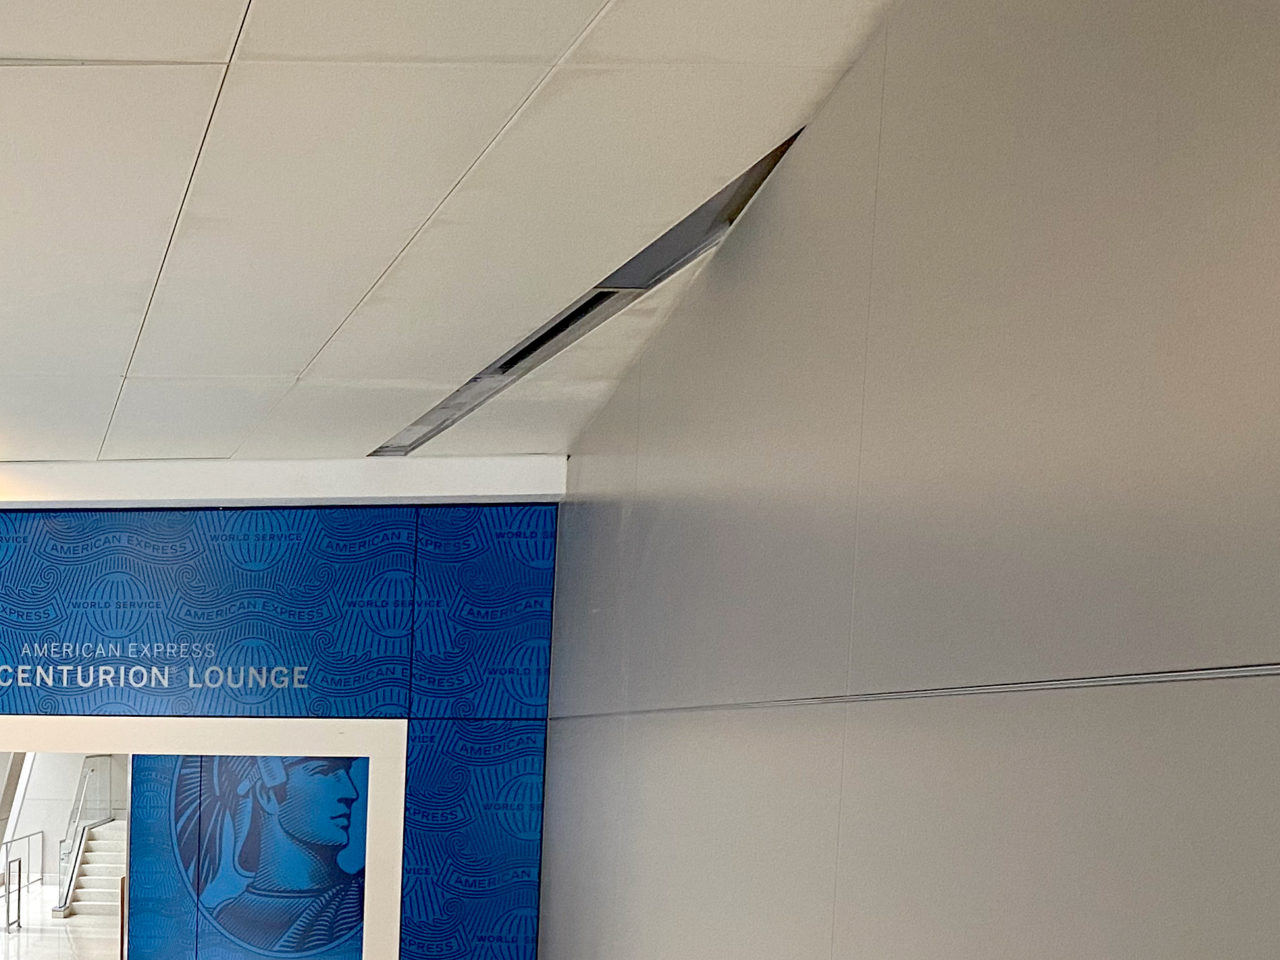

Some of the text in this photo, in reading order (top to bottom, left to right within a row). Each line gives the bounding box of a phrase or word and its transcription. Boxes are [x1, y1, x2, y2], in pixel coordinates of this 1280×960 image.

[50, 534, 187, 555] AMERICAN EXPRESS
[209, 532, 303, 542] WORLD SERVICE
[325, 531, 472, 552] AMERICAN EXPRESS
[495, 531, 538, 540] WORLD
[71, 600, 163, 609] WORLD SERVICE
[183, 600, 324, 620] AMERICAN EXPRESS
[346, 600, 443, 609] WORLD SERVICE
[466, 599, 544, 620] AMERICAN
[20, 642, 216, 658] AMERICAN EXPRESS
[188, 665, 309, 689] LOUNGE
[320, 666, 395, 687] AMERICAN
[401, 667, 465, 687] EXPRESS
[488, 667, 531, 676] WORLD
[459, 735, 537, 757] AMERICAN
[483, 802, 524, 811] WORLD
[453, 869, 531, 889] AMERICAN
[475, 935, 518, 944] WORLD
